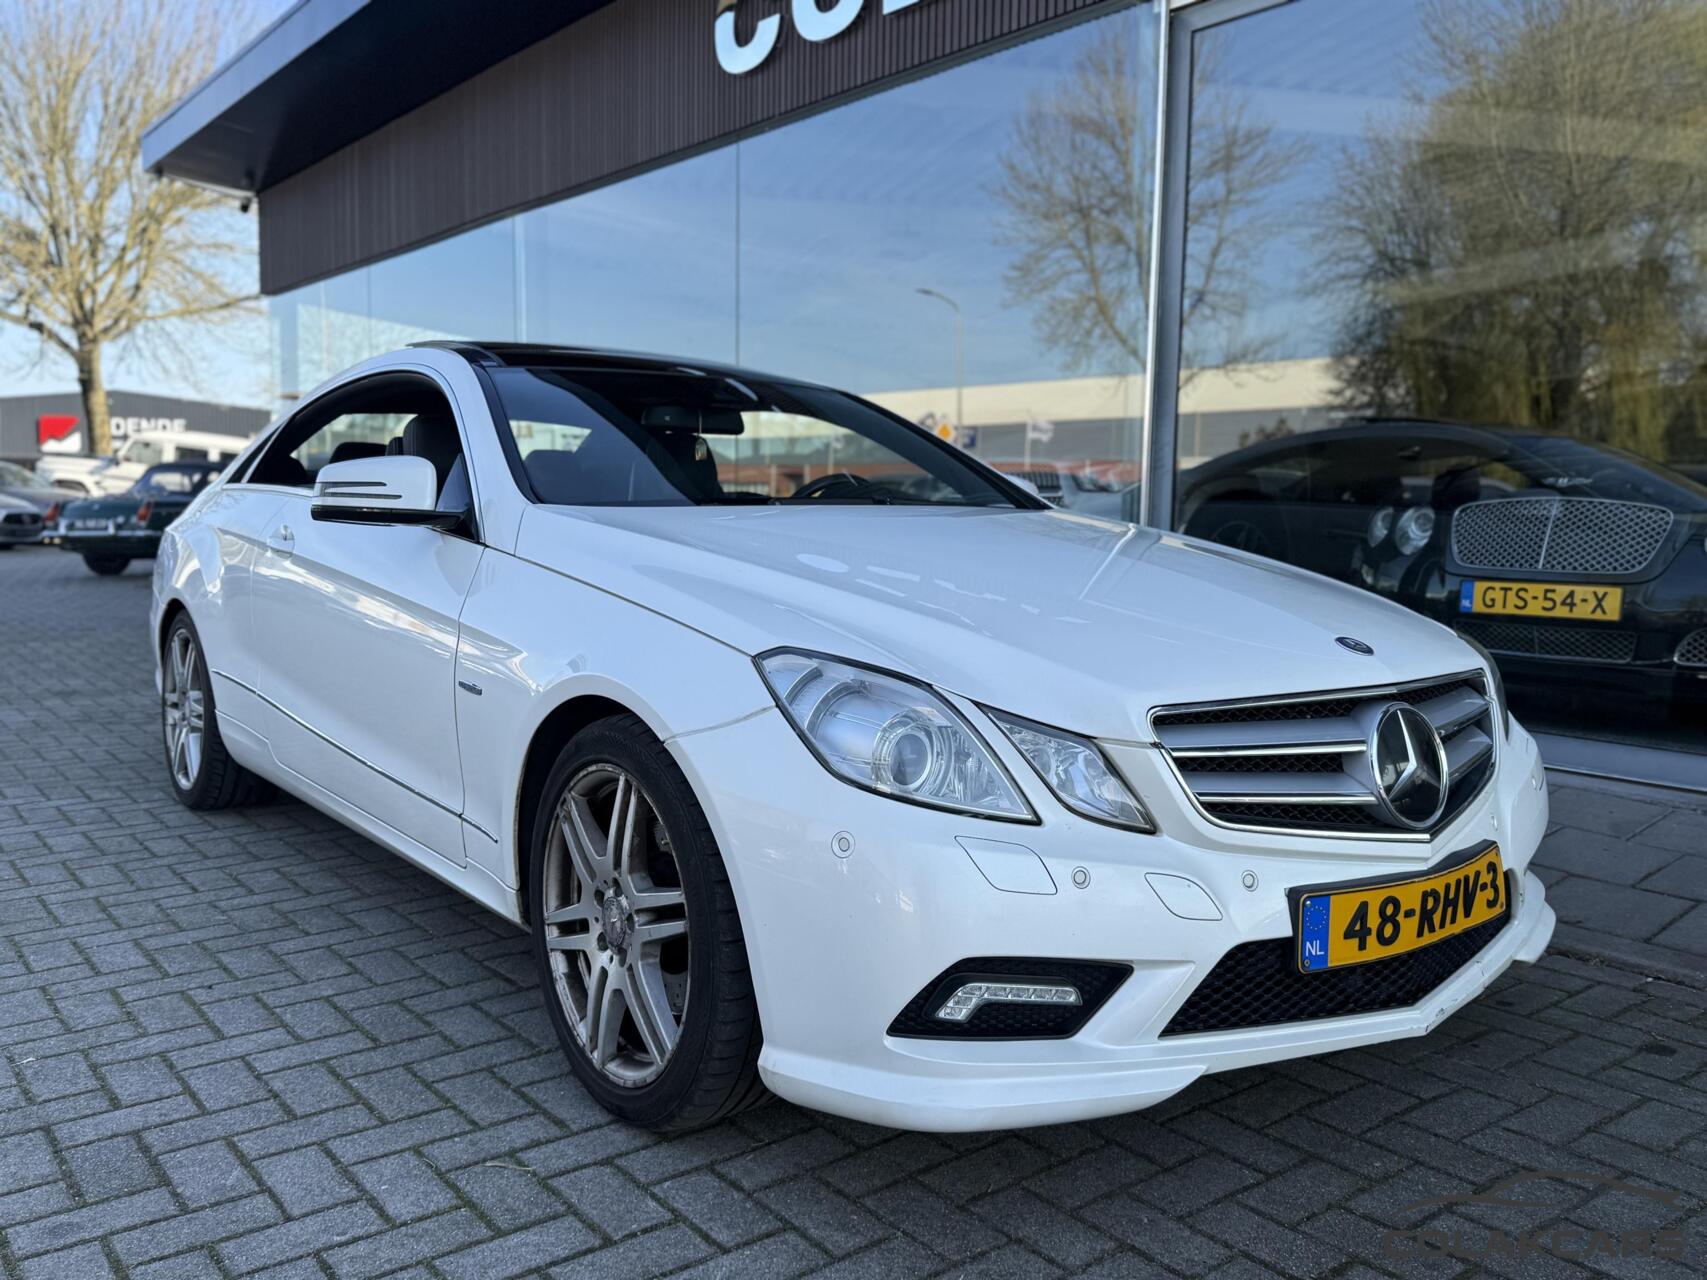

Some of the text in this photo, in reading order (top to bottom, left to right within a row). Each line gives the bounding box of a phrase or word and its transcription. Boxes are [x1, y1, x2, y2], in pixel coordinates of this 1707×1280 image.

[1482, 586, 1608, 615] GTS-54-X
[1343, 861, 1500, 951] 48-RHV-3
[1305, 940, 1324, 956] NL
